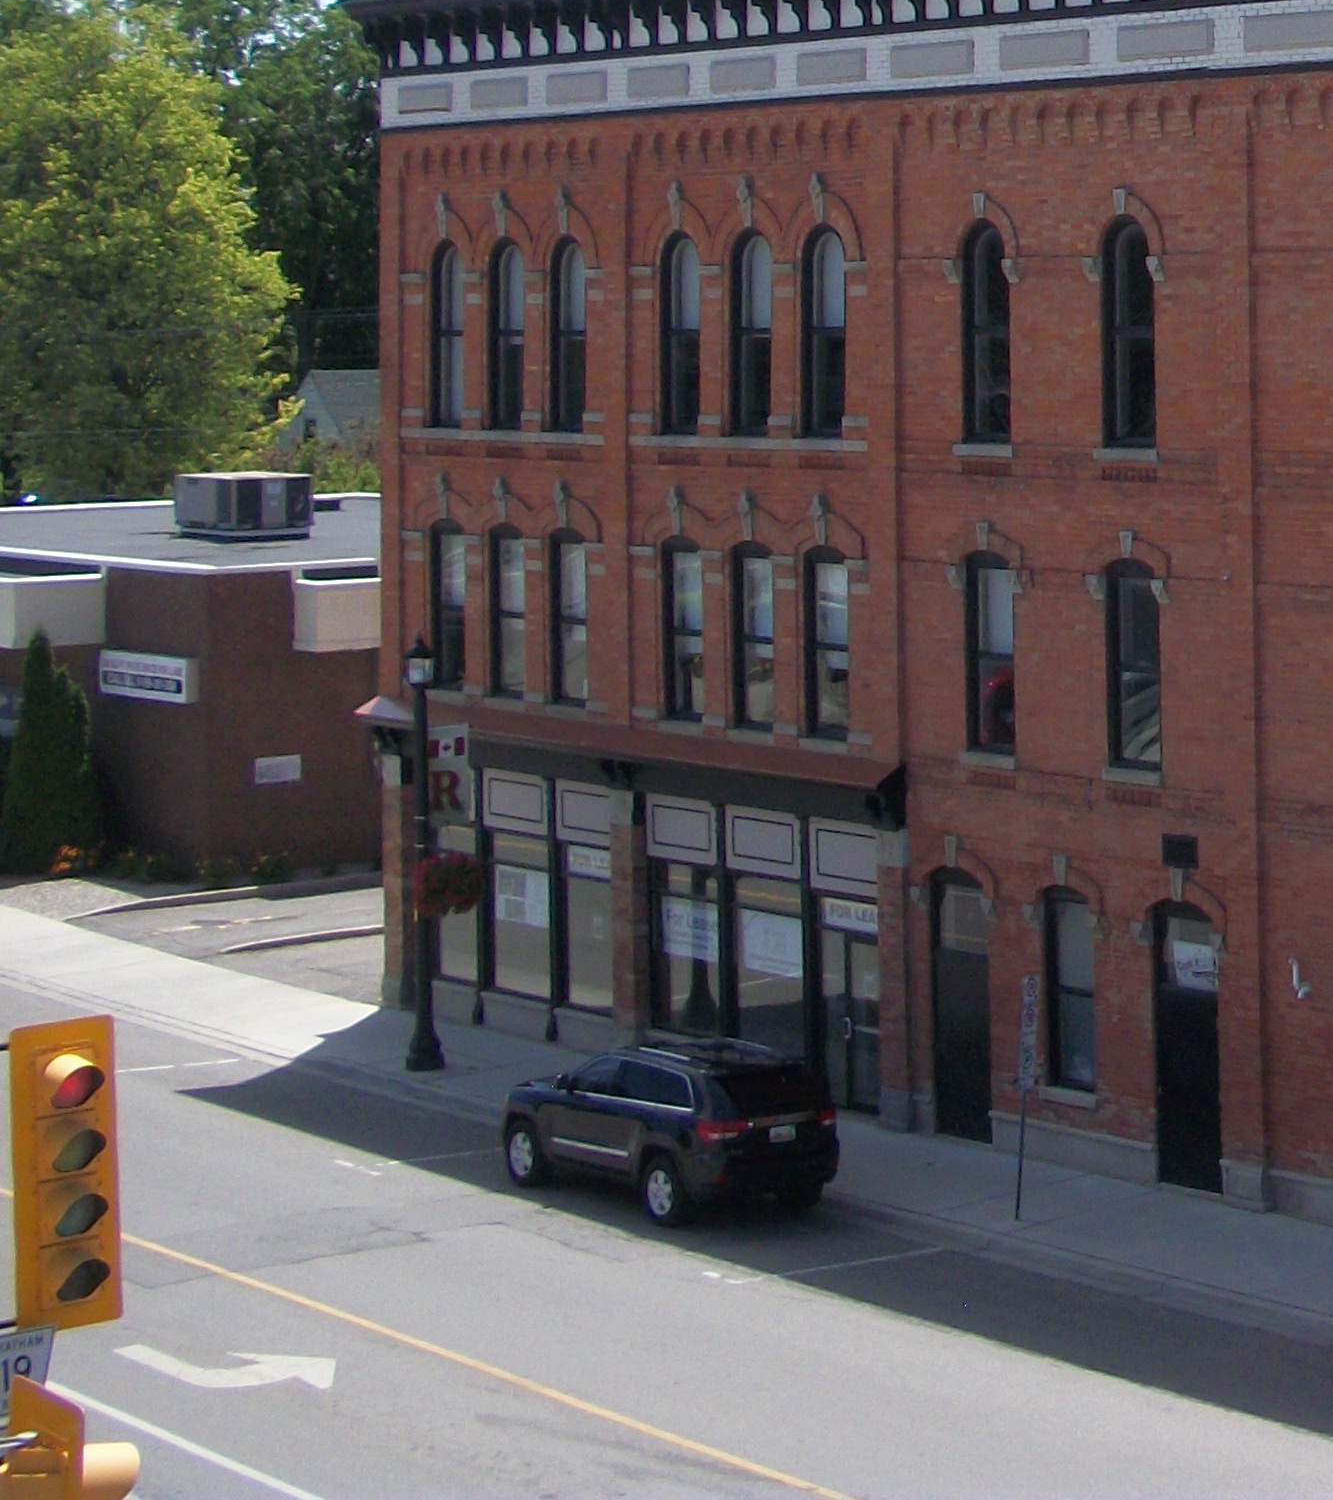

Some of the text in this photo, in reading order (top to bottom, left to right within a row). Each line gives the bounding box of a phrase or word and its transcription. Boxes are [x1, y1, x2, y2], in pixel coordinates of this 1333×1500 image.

[429, 770, 464, 811] R
[830, 902, 876, 924] FOR LEA
